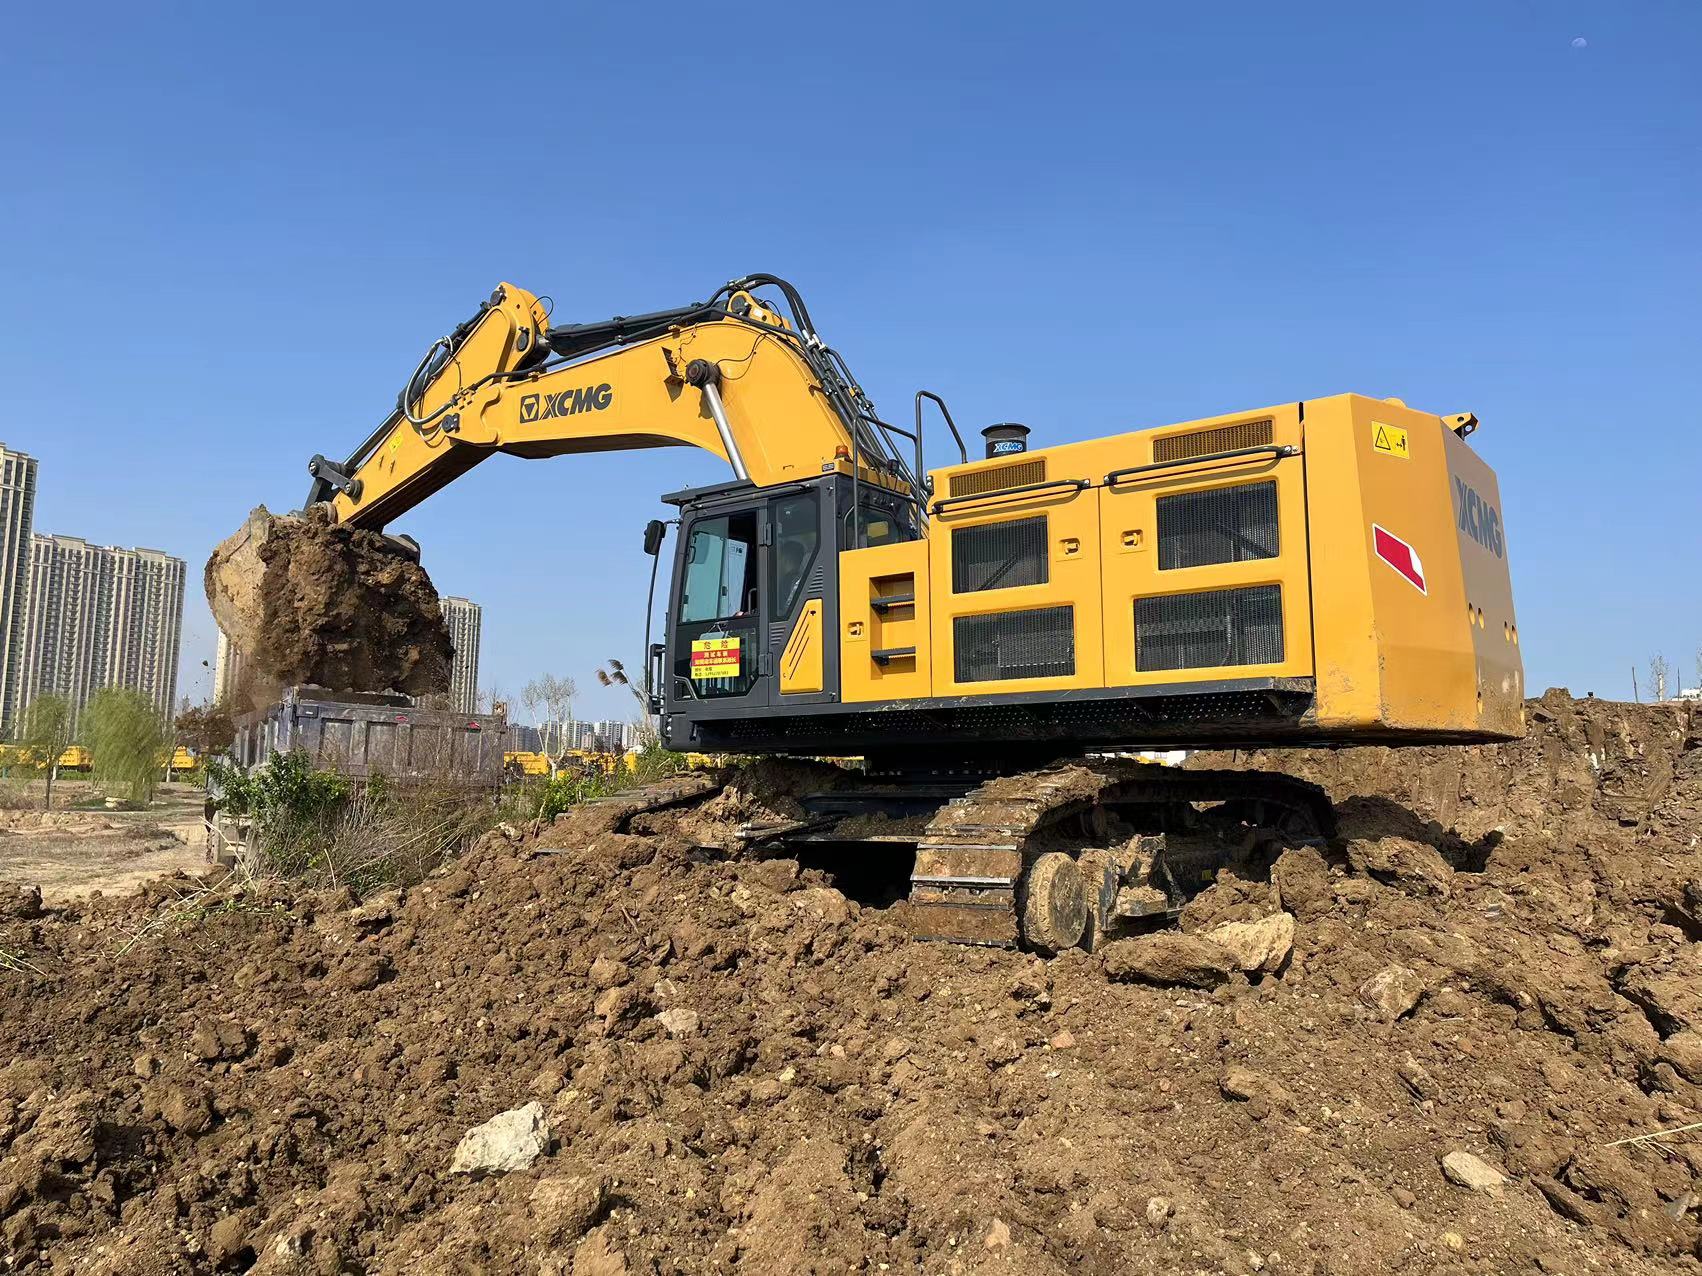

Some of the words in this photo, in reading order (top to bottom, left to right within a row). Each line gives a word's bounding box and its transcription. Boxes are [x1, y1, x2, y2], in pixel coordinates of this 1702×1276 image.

[539, 383, 612, 420] XCMG
[993, 442, 1023, 452] XCMG
[1455, 475, 1502, 559] XCMG
